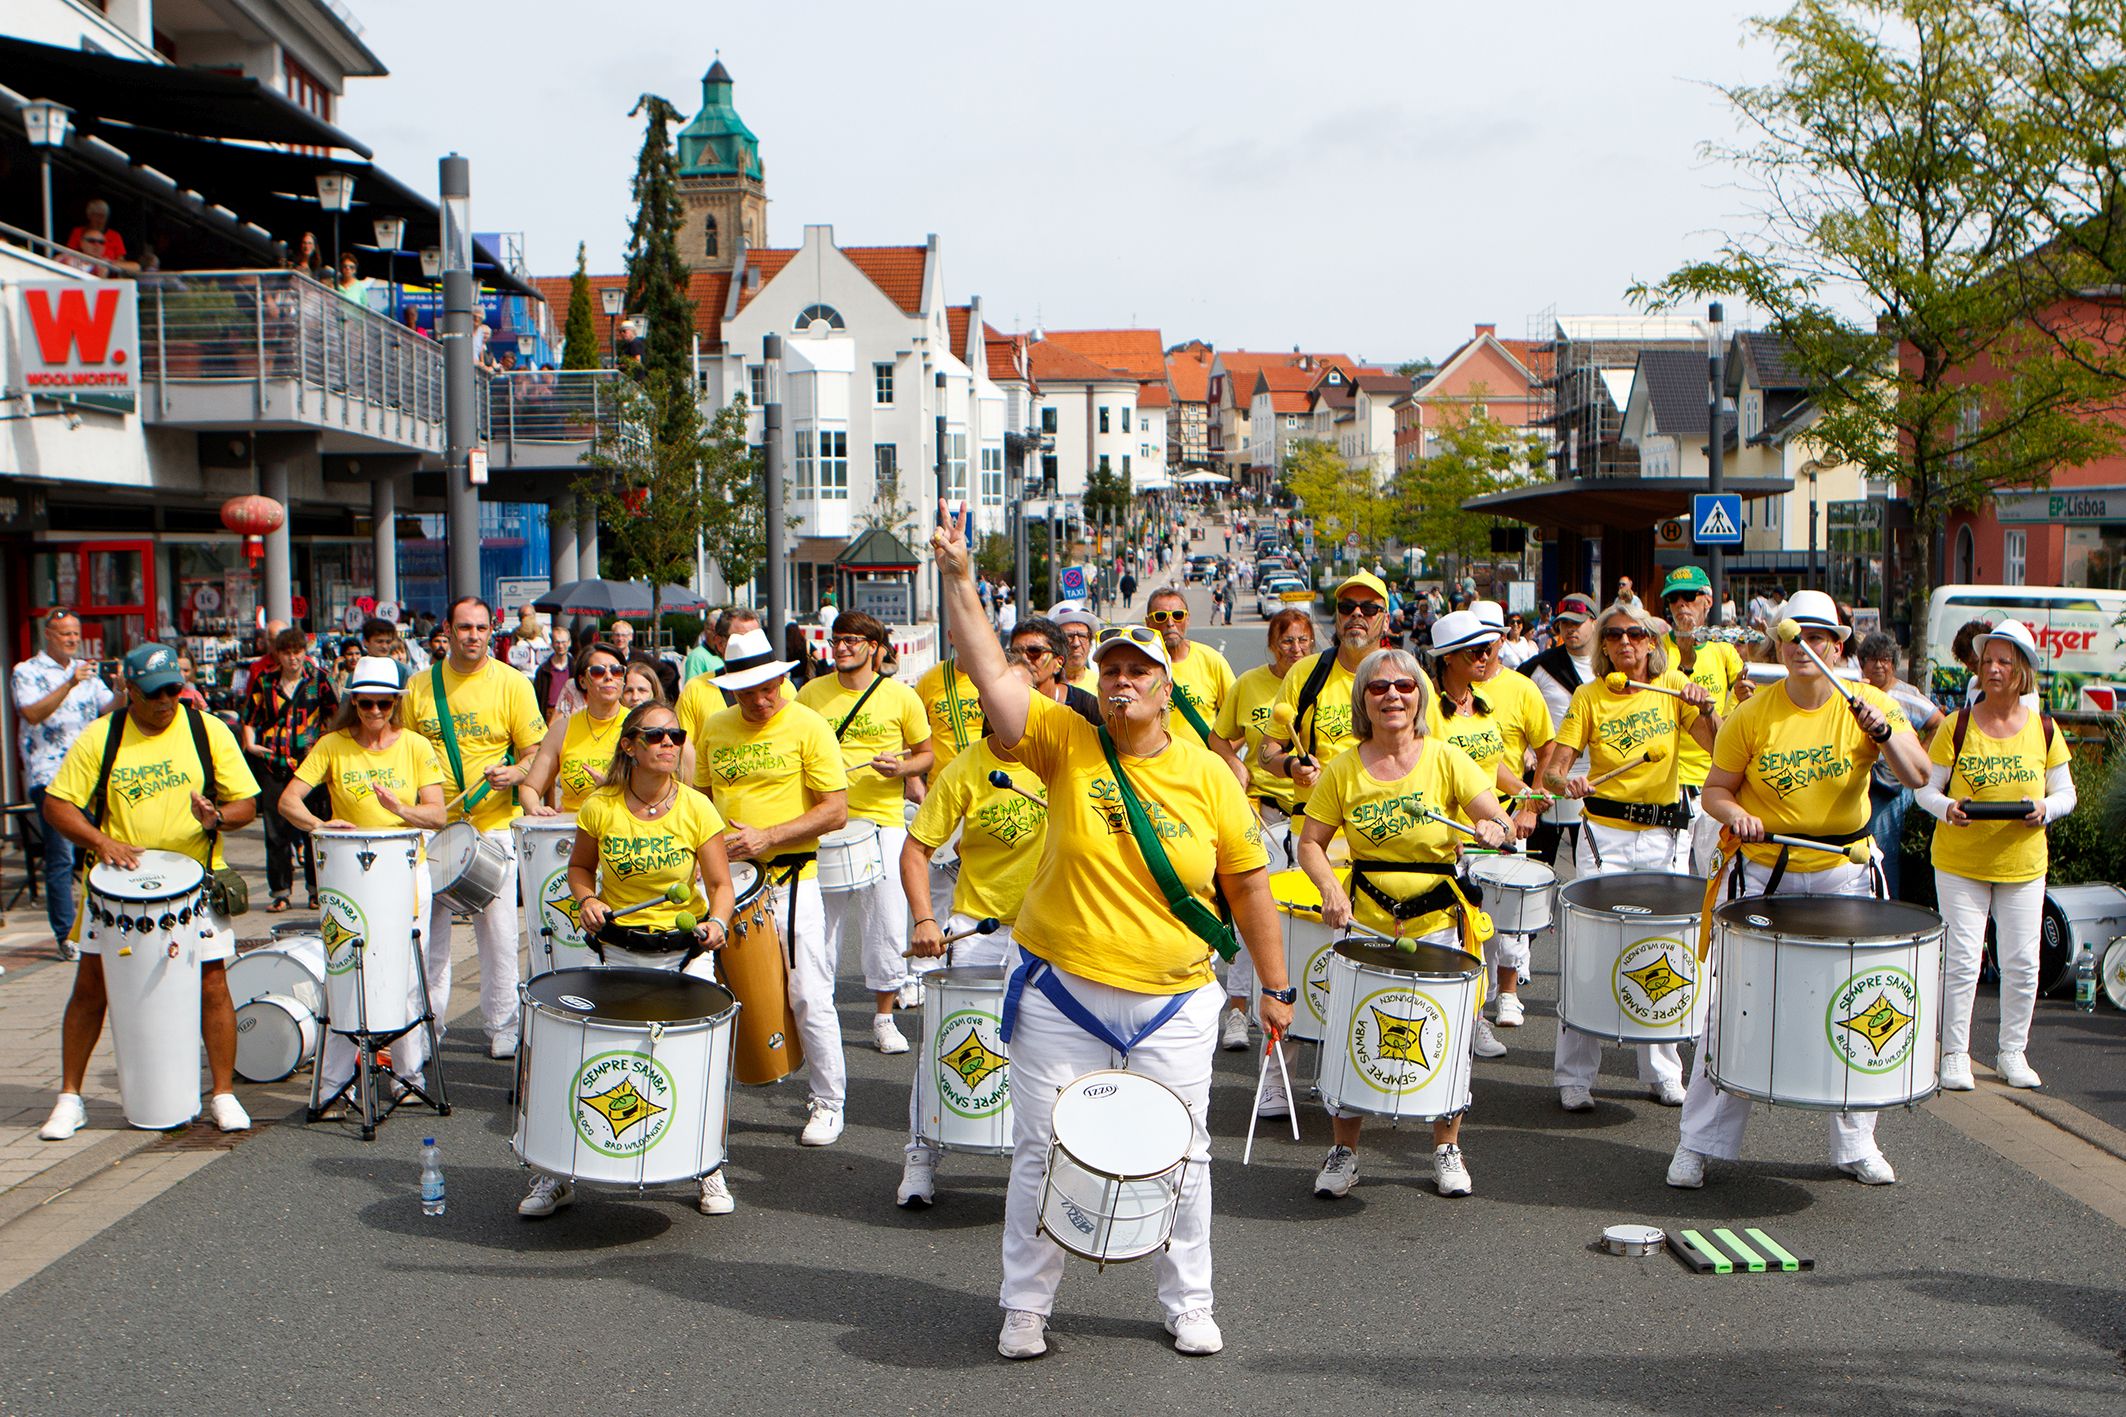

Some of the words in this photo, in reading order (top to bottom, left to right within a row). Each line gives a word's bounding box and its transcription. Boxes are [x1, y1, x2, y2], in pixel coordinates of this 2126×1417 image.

[25, 289, 127, 364] W.
[26, 373, 128, 386] WOOLWORTH
[2049, 496, 2106, 516] EP:Lisboa
[1066, 589, 1084, 598] TAXI
[380, 606, 394, 618] 6€
[76, 638, 103, 659] ALE
[846, 724, 887, 739] SAMBA
[1600, 708, 1662, 738] SEMPRE
[1633, 719, 1679, 743] SAMBA
[712, 742, 772, 765] SEMPRE
[1478, 742, 1504, 759] SAMB
[1758, 745, 1835, 772] SEMPRE
[111, 760, 173, 783] SEMPRE
[739, 756, 786, 776] SAMBA
[1795, 758, 1853, 784] SAMBA
[1958, 755, 2023, 771] SEMPRE
[143, 772, 191, 792] SAMBA
[343, 767, 395, 785] SEMPRE
[1988, 770, 2038, 785] SAMBA
[603, 835, 675, 855] SEMPRE
[634, 848, 690, 871] SAMBA
[329, 896, 358, 924] SAMBA
[2046, 919, 2058, 944] IZZO
[1624, 943, 1659, 966] WILDUNGEN
[1660, 943, 1675, 951] BAD
[1380, 994, 1425, 1008] WILDUNGEN
[1621, 986, 1650, 1017] SAMBA
[1839, 975, 1882, 1012] SEMPRE
[1885, 975, 1915, 1005] SAMBA
[1426, 1006, 1438, 1021] BAD
[1652, 993, 1690, 1020] SEMPRE
[967, 1017, 983, 1026] BAD
[1355, 1020, 1370, 1064] SAMBA
[1433, 1032, 1443, 1059] BLOCO
[1836, 1034, 1856, 1058] BLOCO
[1867, 1058, 1883, 1067] BAD
[582, 1059, 629, 1089] SEMPRE
[632, 1061, 669, 1096] SAMBA
[1367, 1064, 1417, 1086] SEMPRE
[941, 1073, 969, 1108] SAMBA
[1088, 1085, 1113, 1097] IZZO
[578, 1110, 594, 1136] BLOCO
[604, 1140, 622, 1151] BAD
[624, 1119, 665, 1151] WILDUNGEN
